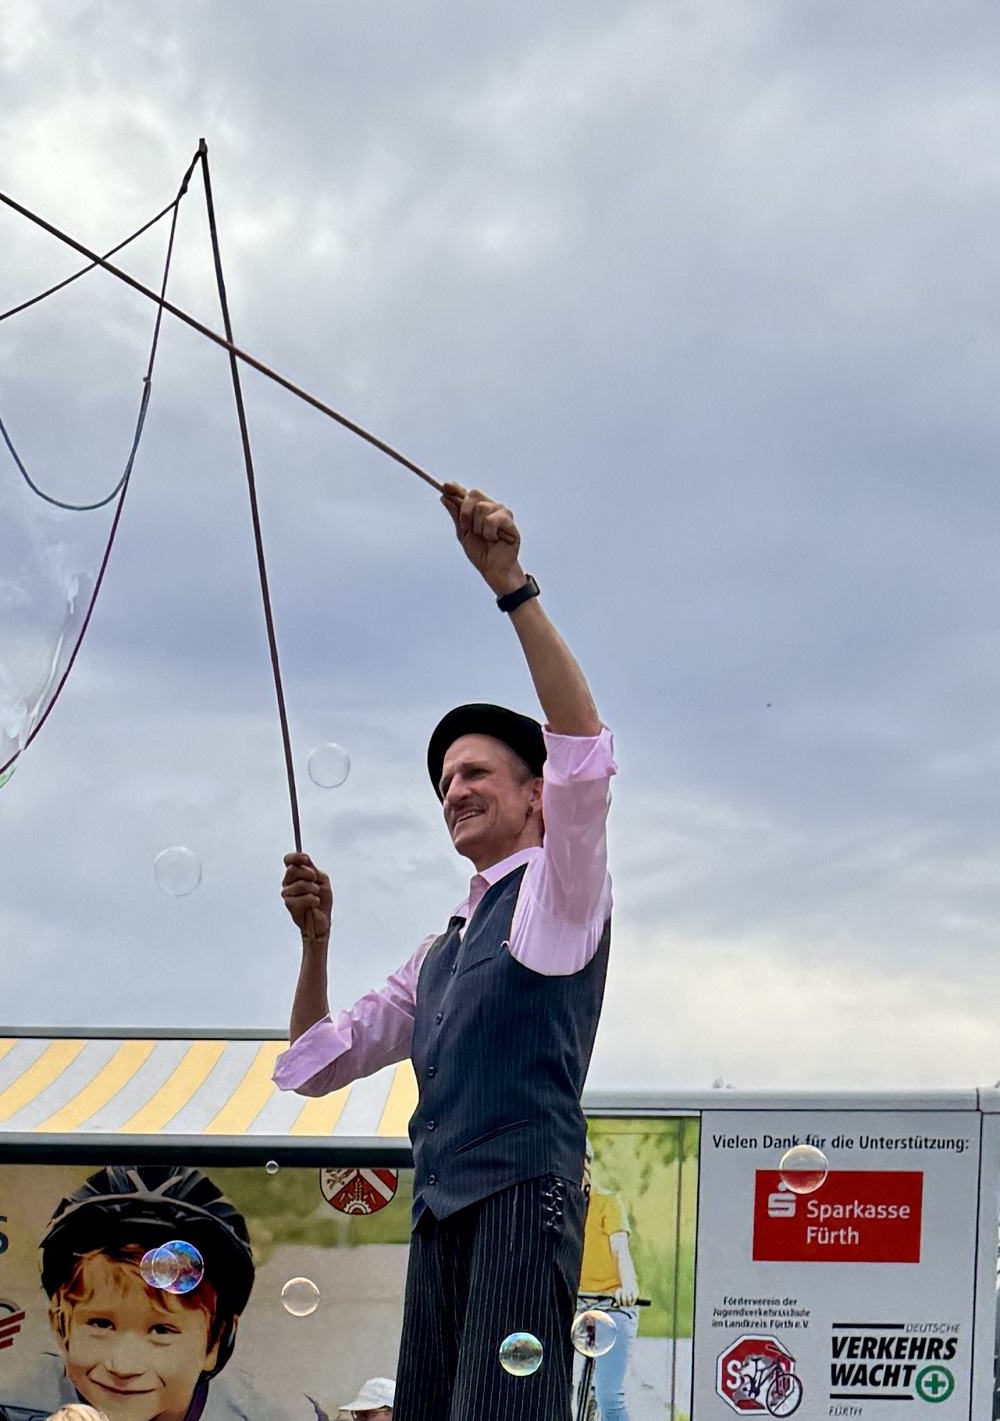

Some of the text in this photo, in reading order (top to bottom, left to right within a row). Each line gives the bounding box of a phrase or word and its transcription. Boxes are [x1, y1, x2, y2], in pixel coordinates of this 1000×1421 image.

[712, 1134, 970, 1152] Vielen Dank für die Unterstützung:
[806, 1199, 911, 1222] Sparkasse
[806, 1226, 860, 1245] Fürth
[905, 1323, 961, 1333] DEUTSCHE
[831, 1336, 958, 1361] VERKEHRS
[830, 1363, 917, 1388] WACHT
